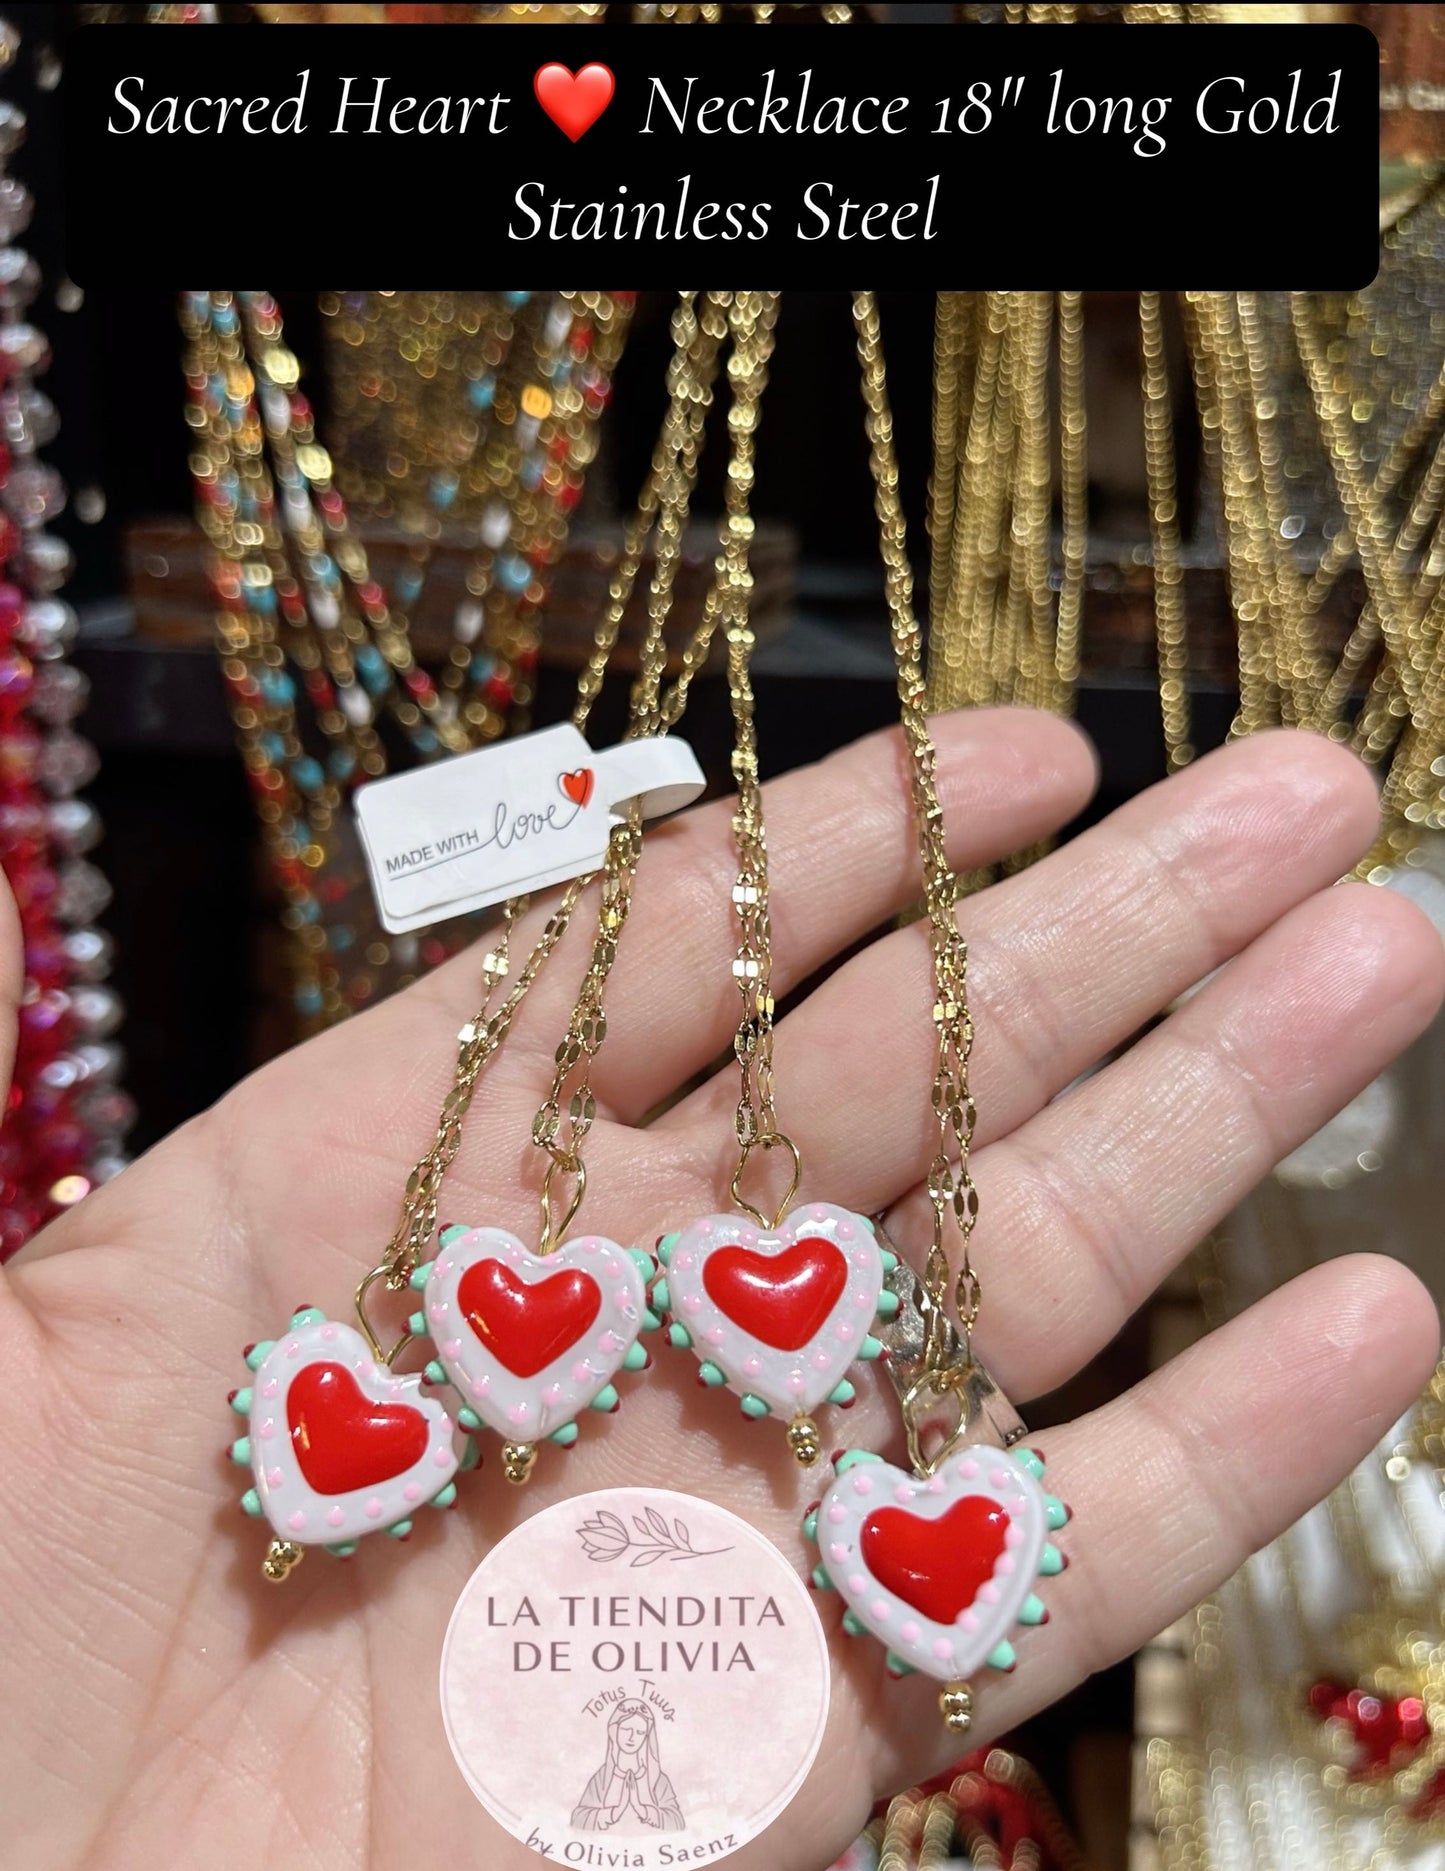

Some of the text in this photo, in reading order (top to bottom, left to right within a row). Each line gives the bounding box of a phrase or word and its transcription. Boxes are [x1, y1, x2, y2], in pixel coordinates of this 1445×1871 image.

[386, 801, 568, 874] MADE WITH love
